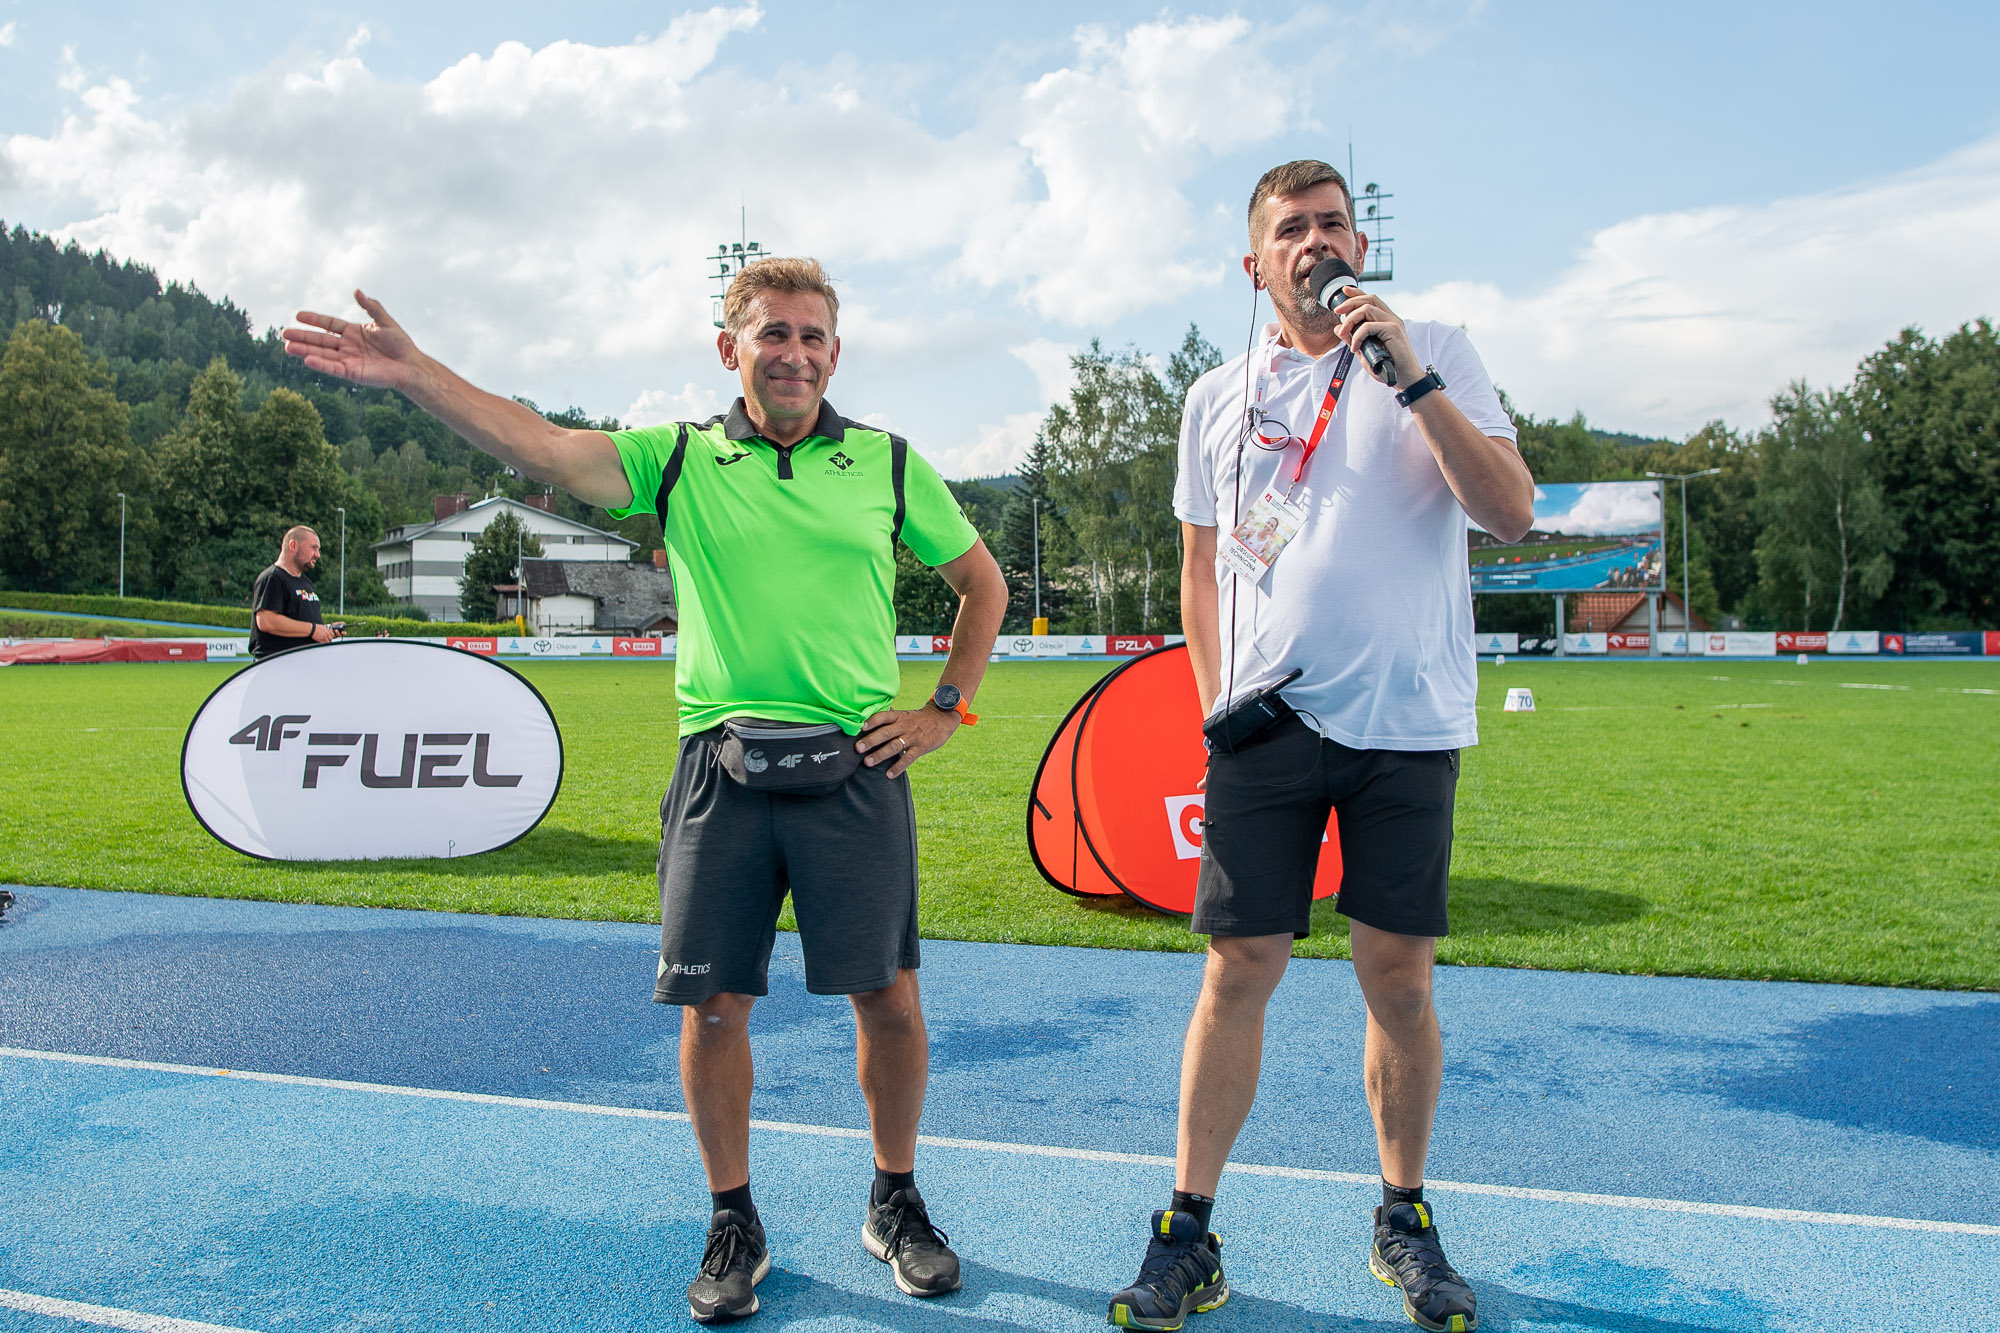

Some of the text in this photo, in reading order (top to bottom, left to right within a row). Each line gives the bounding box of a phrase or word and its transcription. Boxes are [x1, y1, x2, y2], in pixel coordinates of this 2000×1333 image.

[824, 469, 864, 477] ATHLETICS
[206, 643, 233, 651] PORT
[1115, 640, 1154, 651] PZLA
[1520, 638, 1539, 650] 4F
[1518, 695, 1533, 708] 70
[228, 714, 523, 789] 4F FUEL
[777, 753, 805, 768] 4F
[671, 963, 711, 975] ATHLETICS
